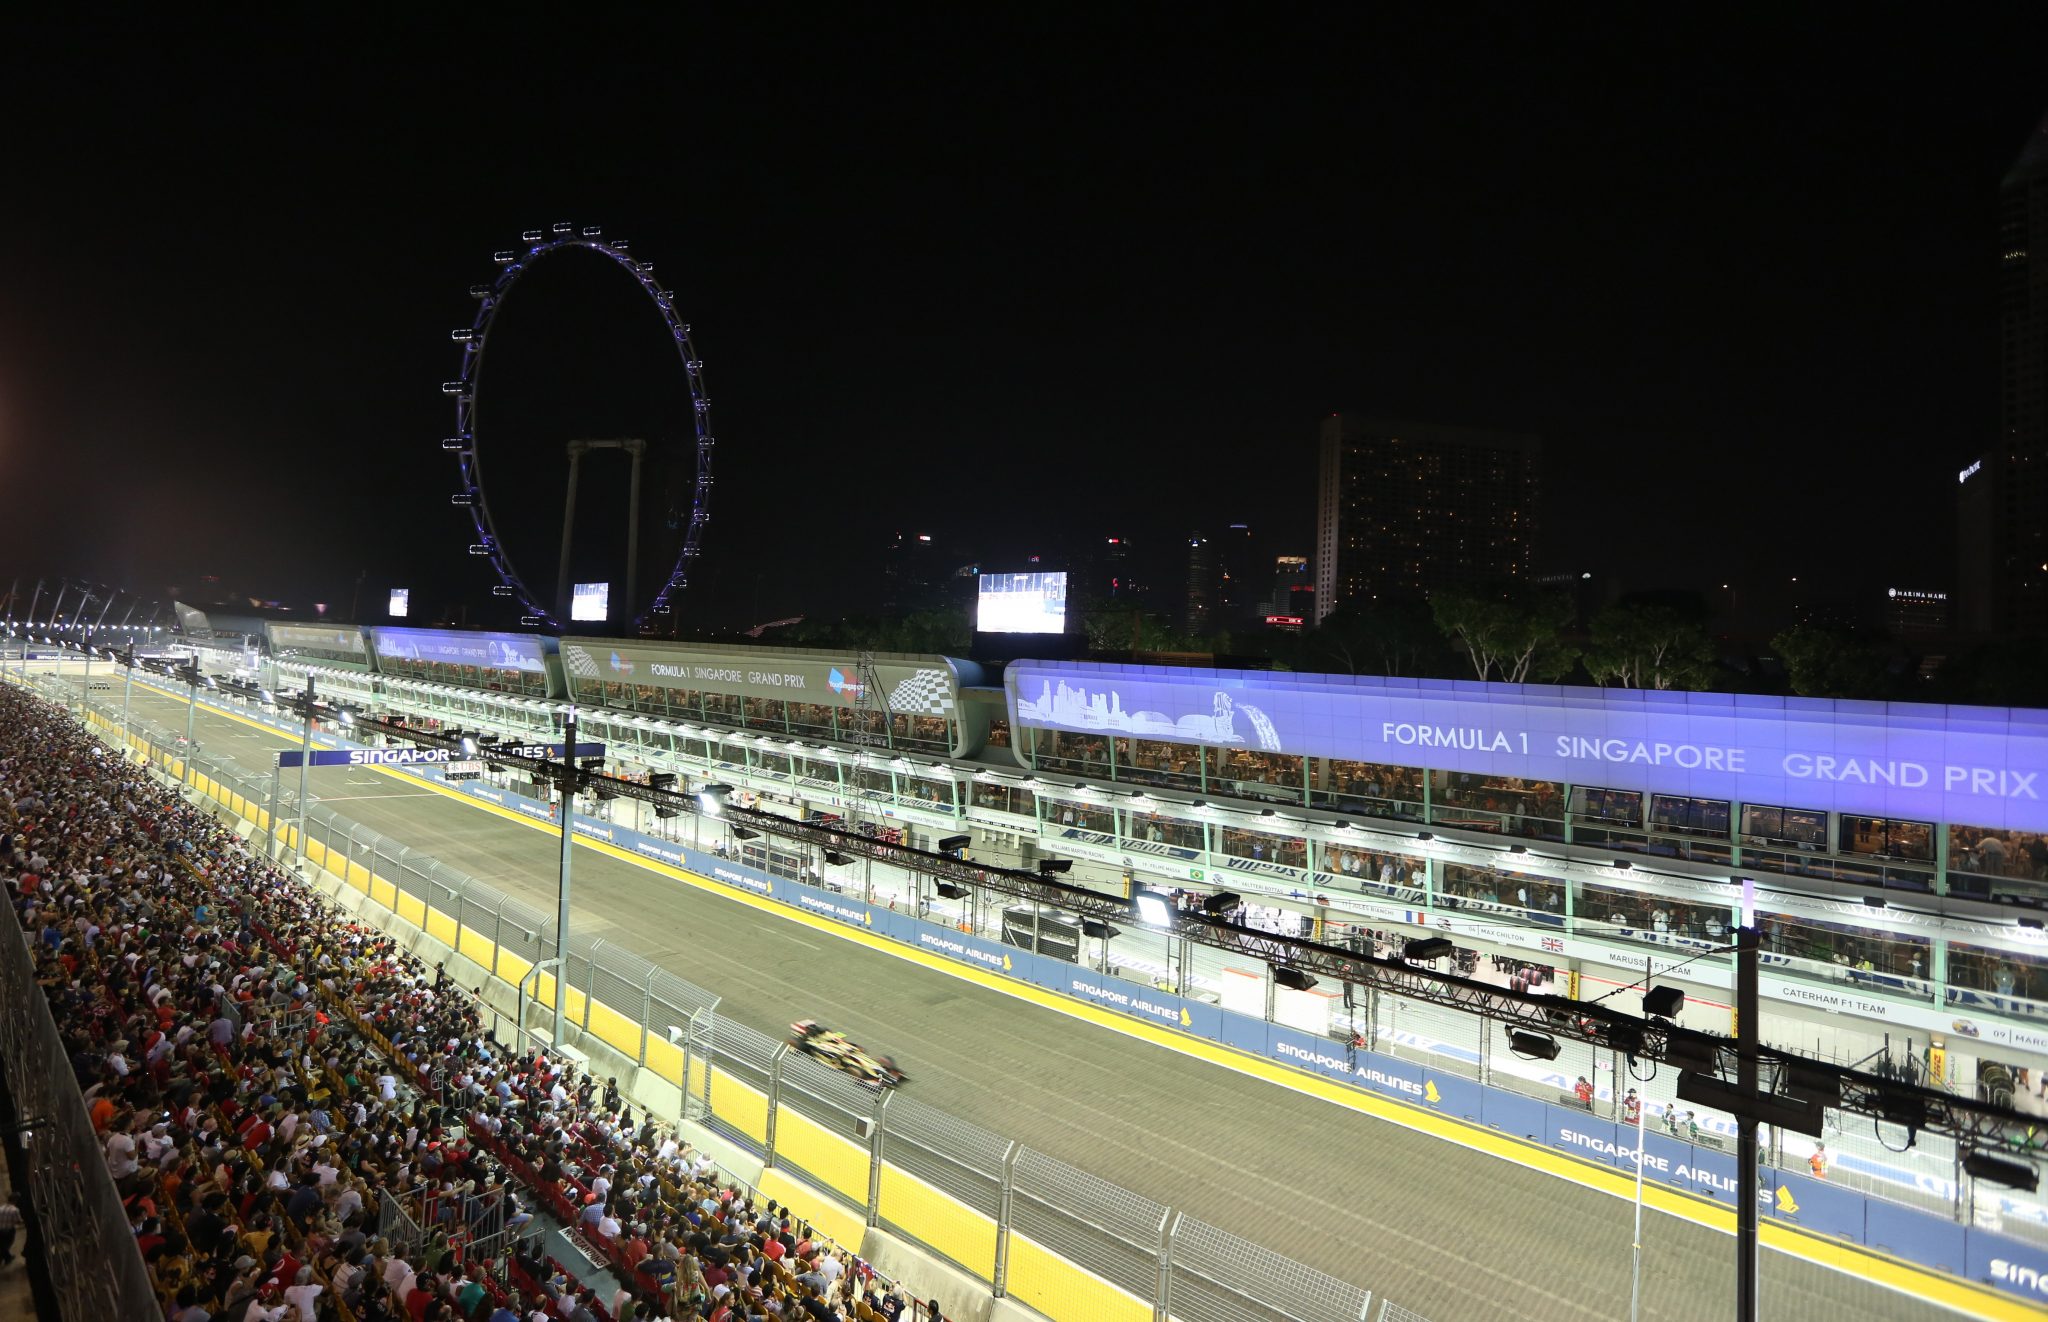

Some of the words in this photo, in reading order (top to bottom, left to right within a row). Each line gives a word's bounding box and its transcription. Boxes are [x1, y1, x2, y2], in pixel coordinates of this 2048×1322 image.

[1897, 590, 1926, 598] MARINA
[650, 664, 686, 678] FORMULA
[686, 668, 690, 678] 1
[694, 668, 742, 682] SINGAPORE
[748, 672, 782, 686] GRAND
[784, 674, 806, 688] PRIX
[461, 762, 481, 772] UBS
[1382, 722, 1514, 755] FORMULA
[1519, 731, 1529, 755] 1
[1556, 734, 1746, 773] SINGAPORE
[1782, 752, 1929, 788] GRAND
[1944, 766, 2039, 800] PRIX
[714, 867, 742, 882] SINGAPORE
[743, 877, 766, 890] AIRLINES
[800, 895, 834, 912] SINGAPORE
[836, 906, 865, 922] AIRLINES
[1352, 903, 1369, 912] JULES
[1370, 906, 1394, 916] BIANCHI
[1480, 928, 1496, 937] MAX
[1496, 931, 1525, 942] CHILTON
[921, 933, 964, 954] SINGAPORE
[965, 947, 1002, 966] AIRLINES
[1654, 962, 1665, 970] F1
[1667, 963, 1691, 976] TEAM
[1072, 980, 1128, 1005] SINGAPORE
[1130, 998, 1179, 1021] AIRLINES
[1783, 987, 1839, 1006] CATERHAM
[1842, 998, 1853, 1008] F1
[1856, 1001, 1886, 1015] TEAM
[1994, 1030, 2005, 1038] 09
[1277, 1042, 1351, 1074] SINGAPORE
[1356, 1066, 1422, 1096] AIRLINES
[1560, 1128, 1669, 1172] SINGAPORE
[1675, 1164, 1773, 1204] AIRLINS
[572, 1237, 607, 1266] STANDING
